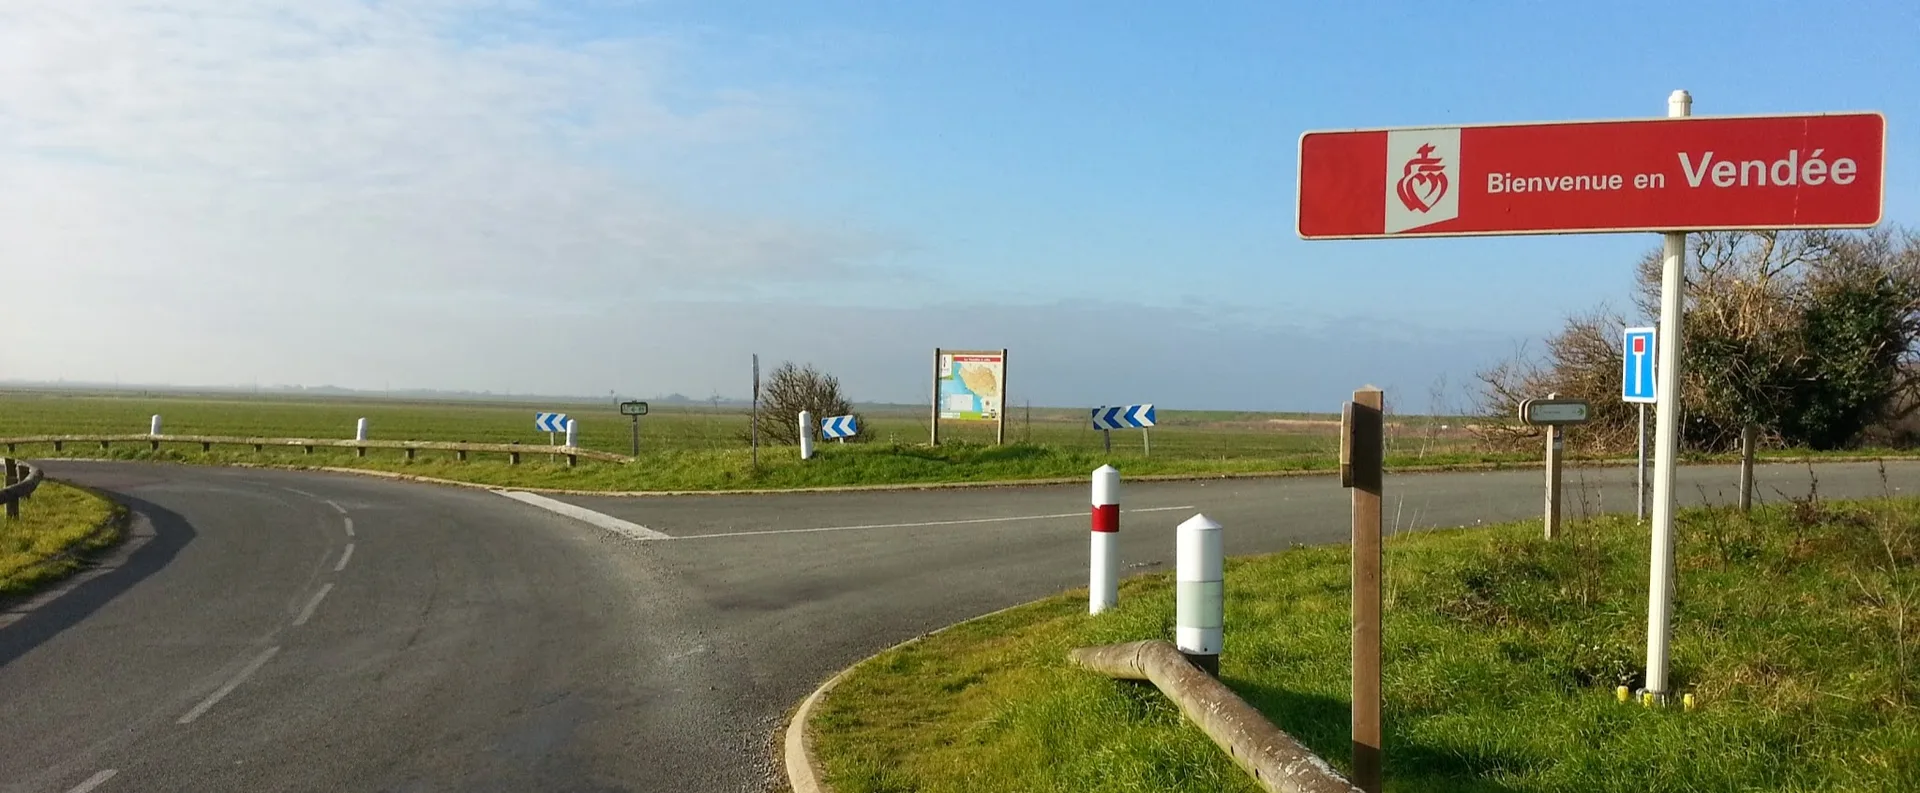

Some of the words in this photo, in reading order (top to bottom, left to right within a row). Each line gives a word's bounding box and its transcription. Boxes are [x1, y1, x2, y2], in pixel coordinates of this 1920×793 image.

[1487, 172, 1623, 194] Bienvenue
[1633, 173, 1665, 190] en
[1677, 149, 1857, 188] Vendée
